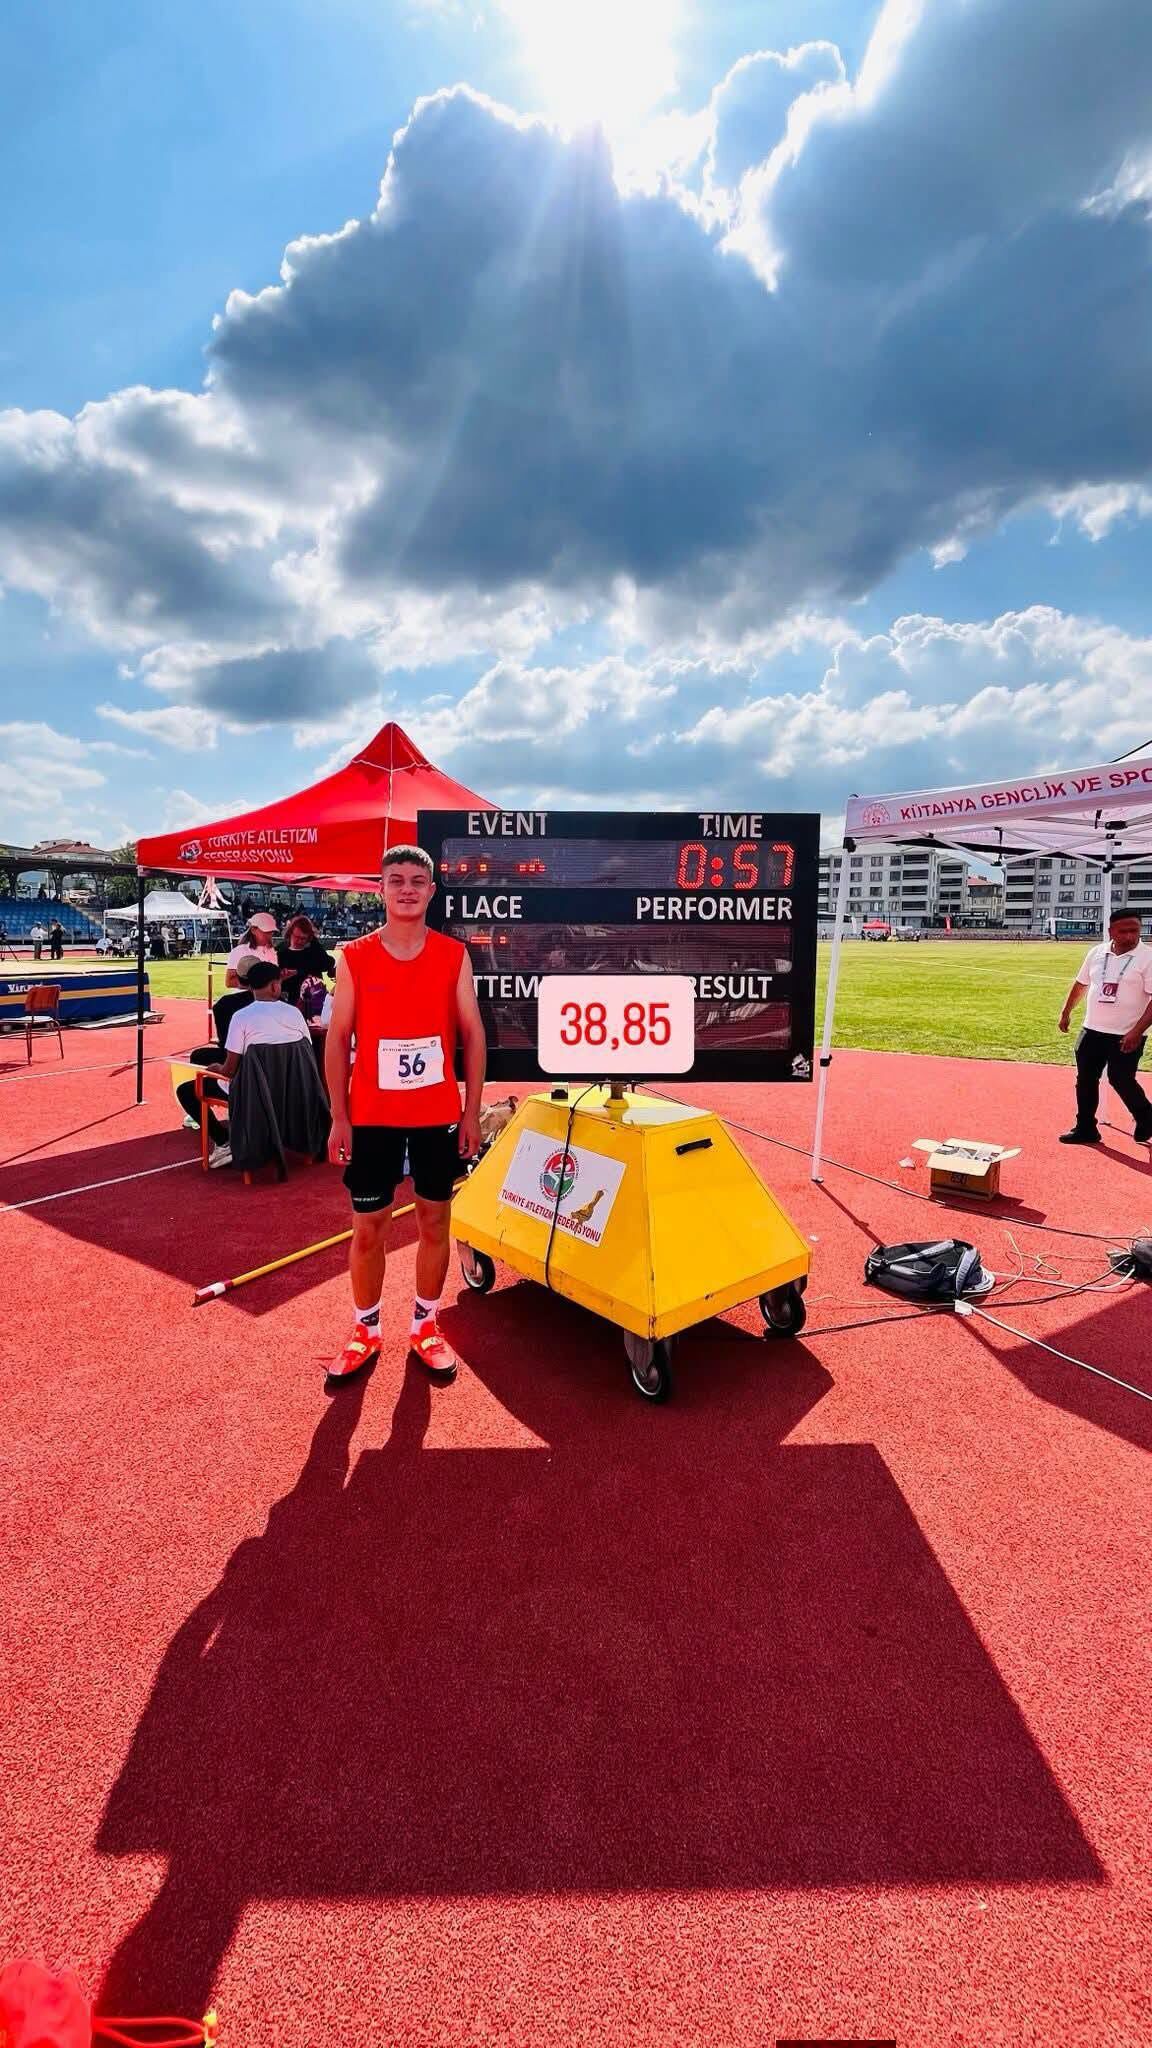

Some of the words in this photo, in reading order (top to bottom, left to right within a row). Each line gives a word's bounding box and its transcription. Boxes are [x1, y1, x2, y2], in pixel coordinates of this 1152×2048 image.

[900, 798, 977, 820] KÜTAHYA
[1072, 776, 1103, 794] VE
[468, 812, 548, 836] EVENT
[698, 814, 763, 838] TIME
[676, 842, 795, 889] 0:57
[636, 896, 793, 920] PERFORMER
[692, 975, 773, 999] RESULT
[398, 1053, 426, 1077] 56
[556, 1213, 602, 1242] EDERASYONU
